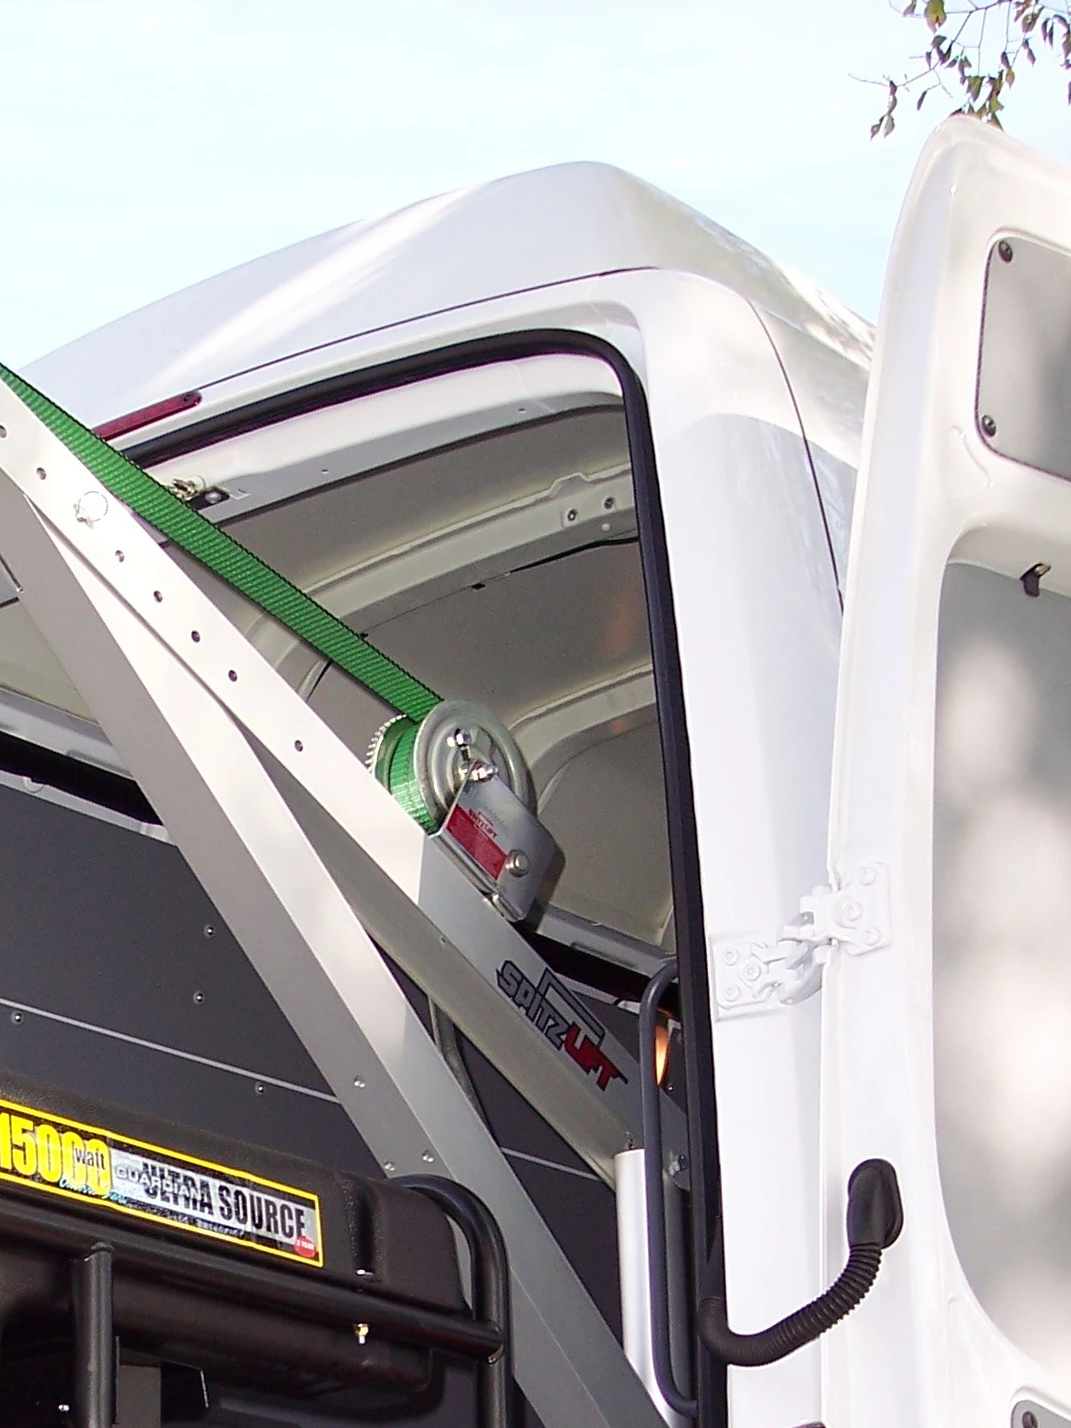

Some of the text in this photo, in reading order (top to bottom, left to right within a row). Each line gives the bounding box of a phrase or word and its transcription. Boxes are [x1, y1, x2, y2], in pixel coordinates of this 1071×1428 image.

[74, 1147, 106, 1171] watt
[114, 1165, 203, 1199] GUARDIAN
[142, 1161, 214, 1216] ULTRA
[218, 1185, 306, 1239] SOURCE
